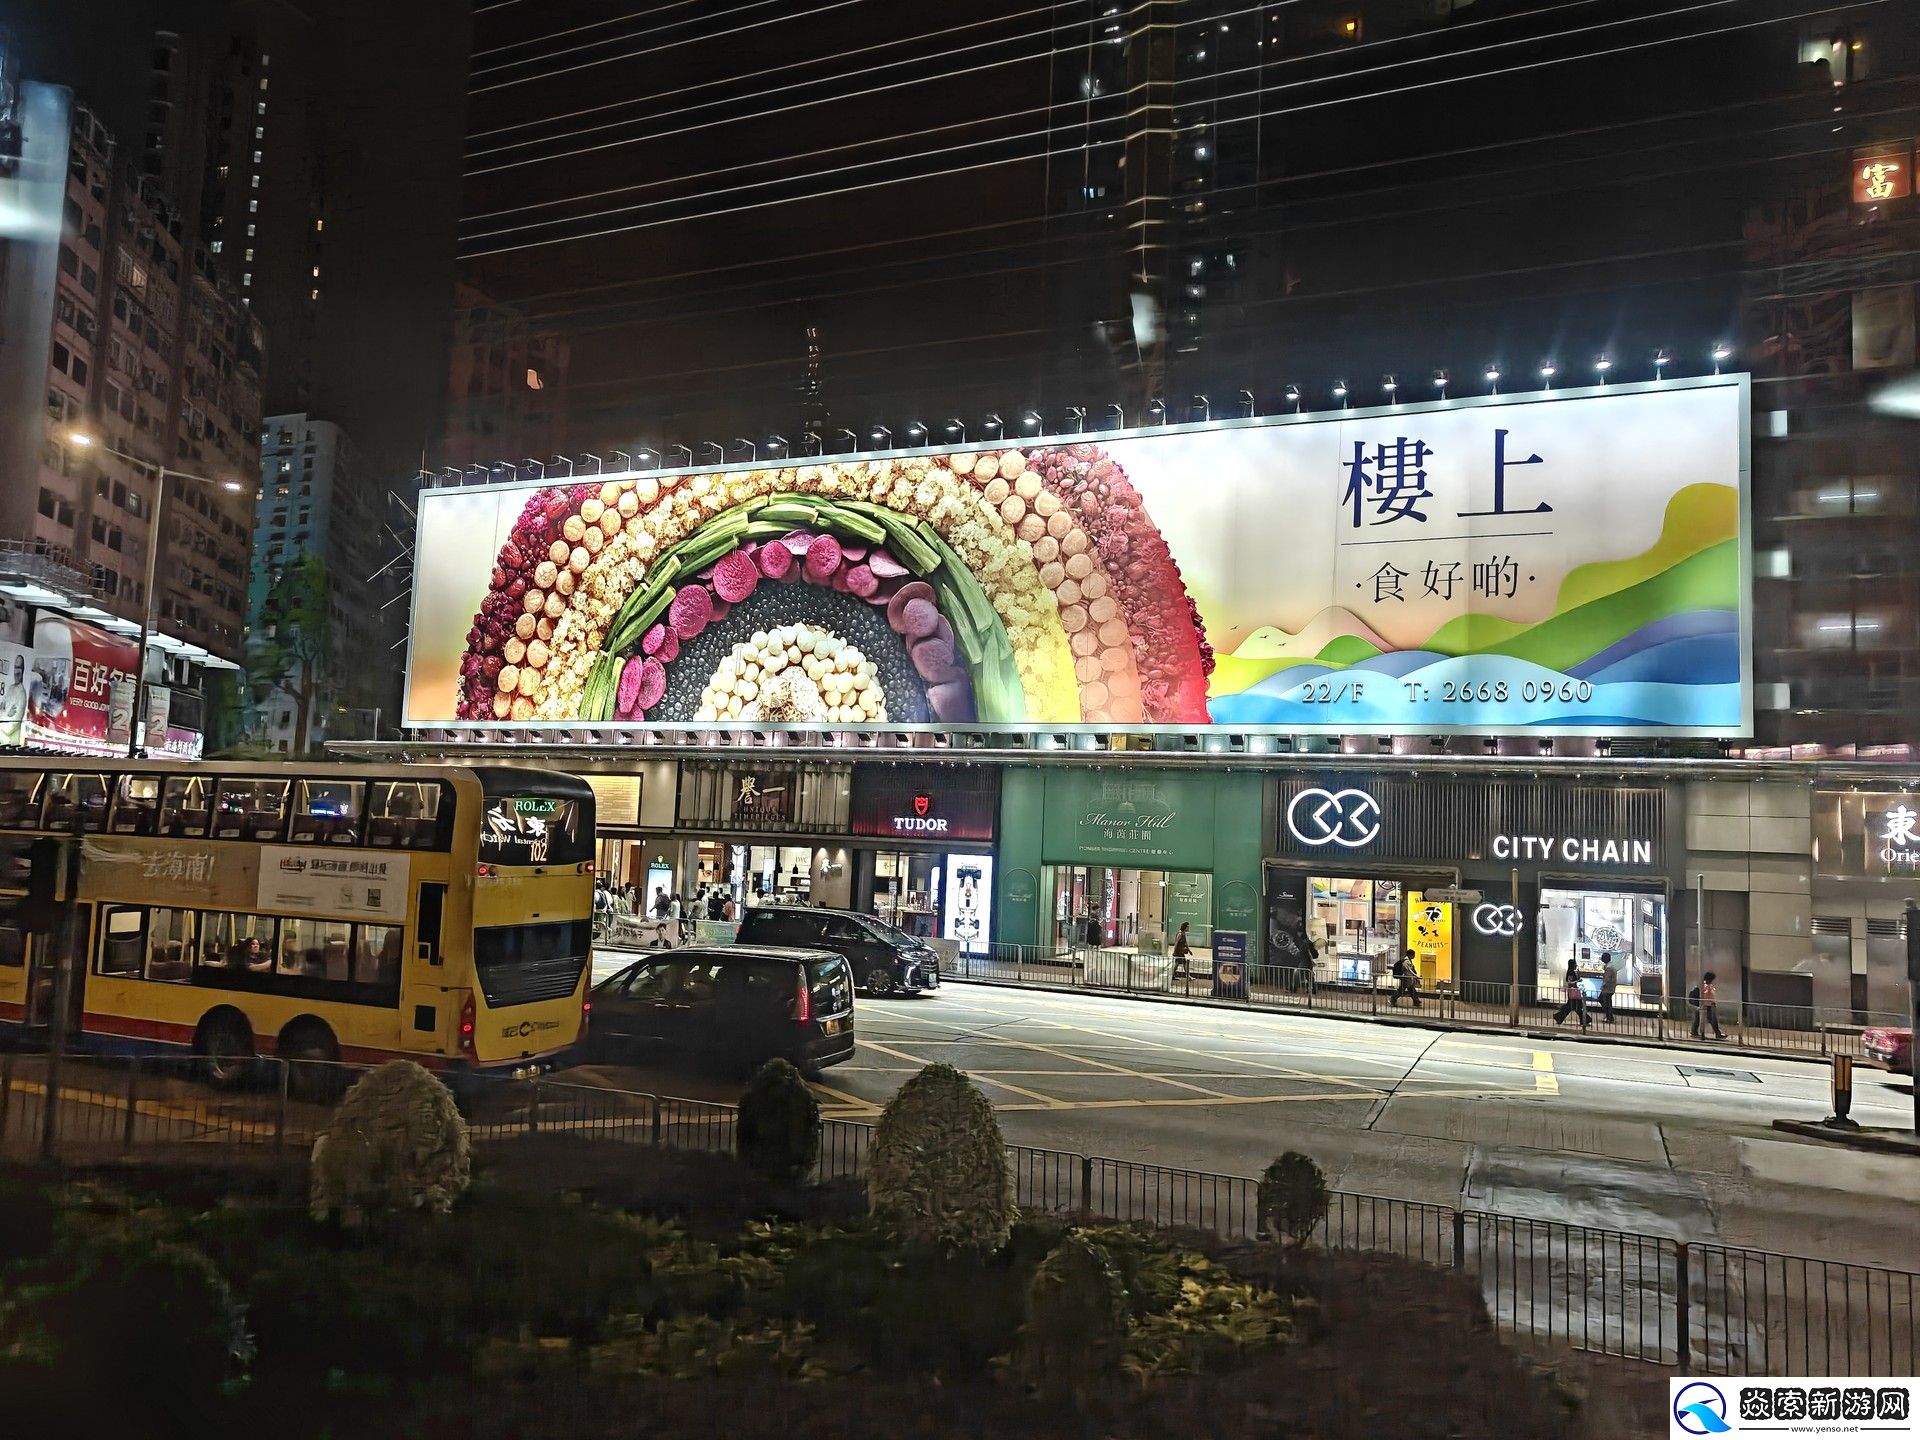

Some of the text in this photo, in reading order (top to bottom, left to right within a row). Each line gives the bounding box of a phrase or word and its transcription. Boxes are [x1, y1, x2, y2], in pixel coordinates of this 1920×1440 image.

[1863, 163, 1900, 199] 富
[1342, 428, 1553, 529] 樓上
[1302, 680, 1593, 703] 22/F T: 2668 0960
[515, 800, 555, 812] ROLEX
[893, 817, 948, 832] TUDOR
[1079, 811, 1176, 829] Manor Hill
[530, 842, 548, 862] 102
[1493, 835, 1651, 863] CITY CHAIN
[1416, 940, 1445, 949] PEANUTS
